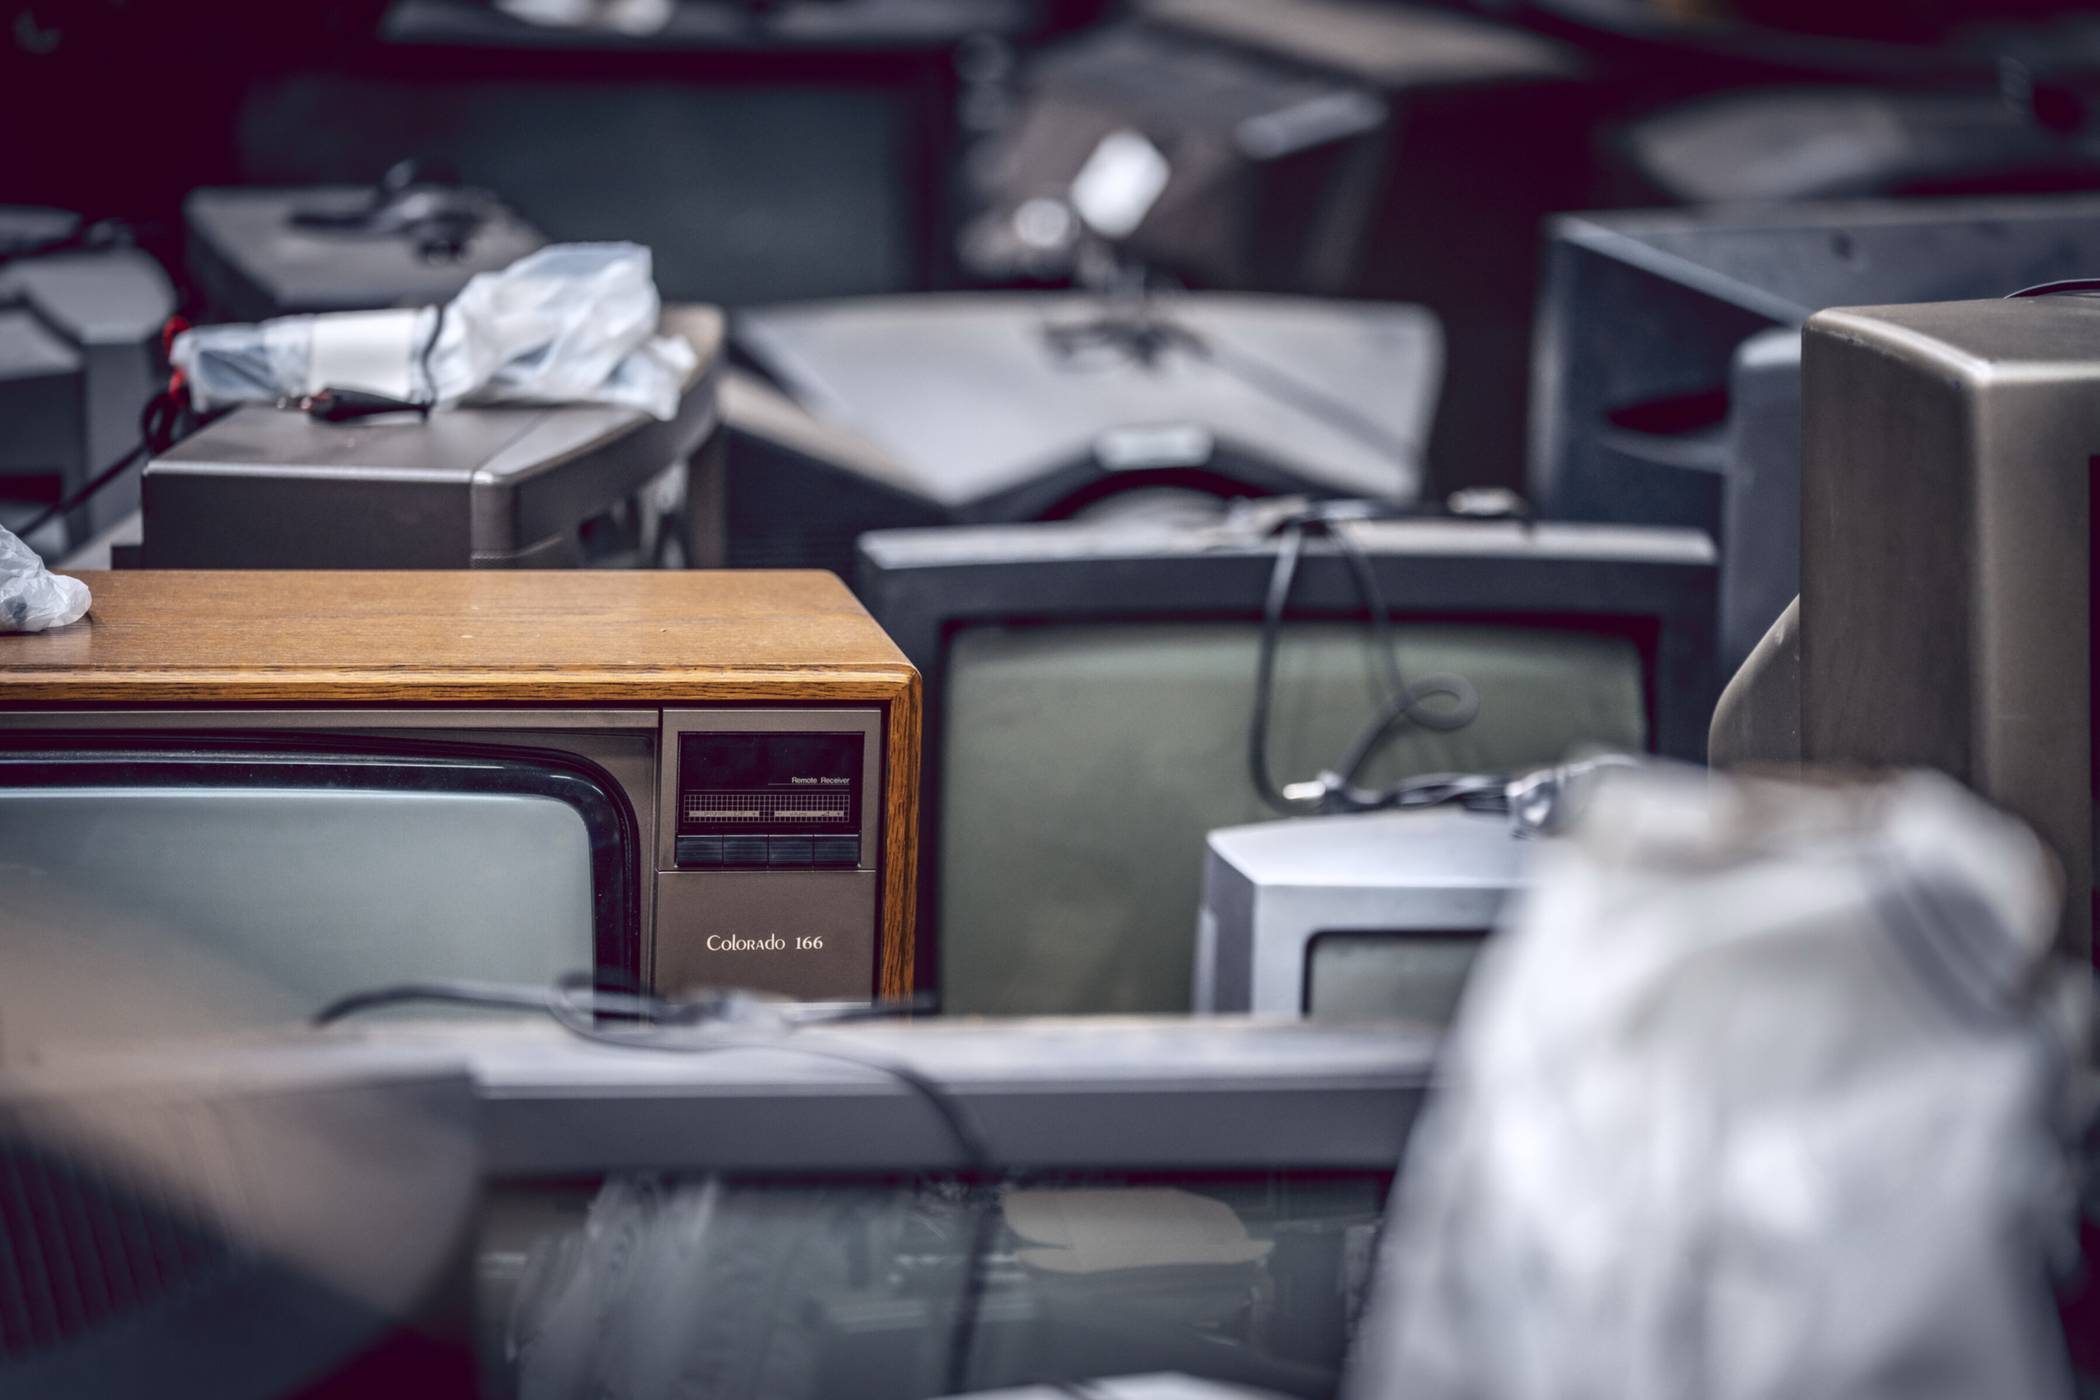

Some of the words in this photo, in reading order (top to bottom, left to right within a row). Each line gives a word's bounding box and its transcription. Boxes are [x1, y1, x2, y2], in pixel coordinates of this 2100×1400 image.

[791, 776, 818, 785] Remote
[820, 776, 850, 785] Receiver
[795, 935, 824, 951] 166
